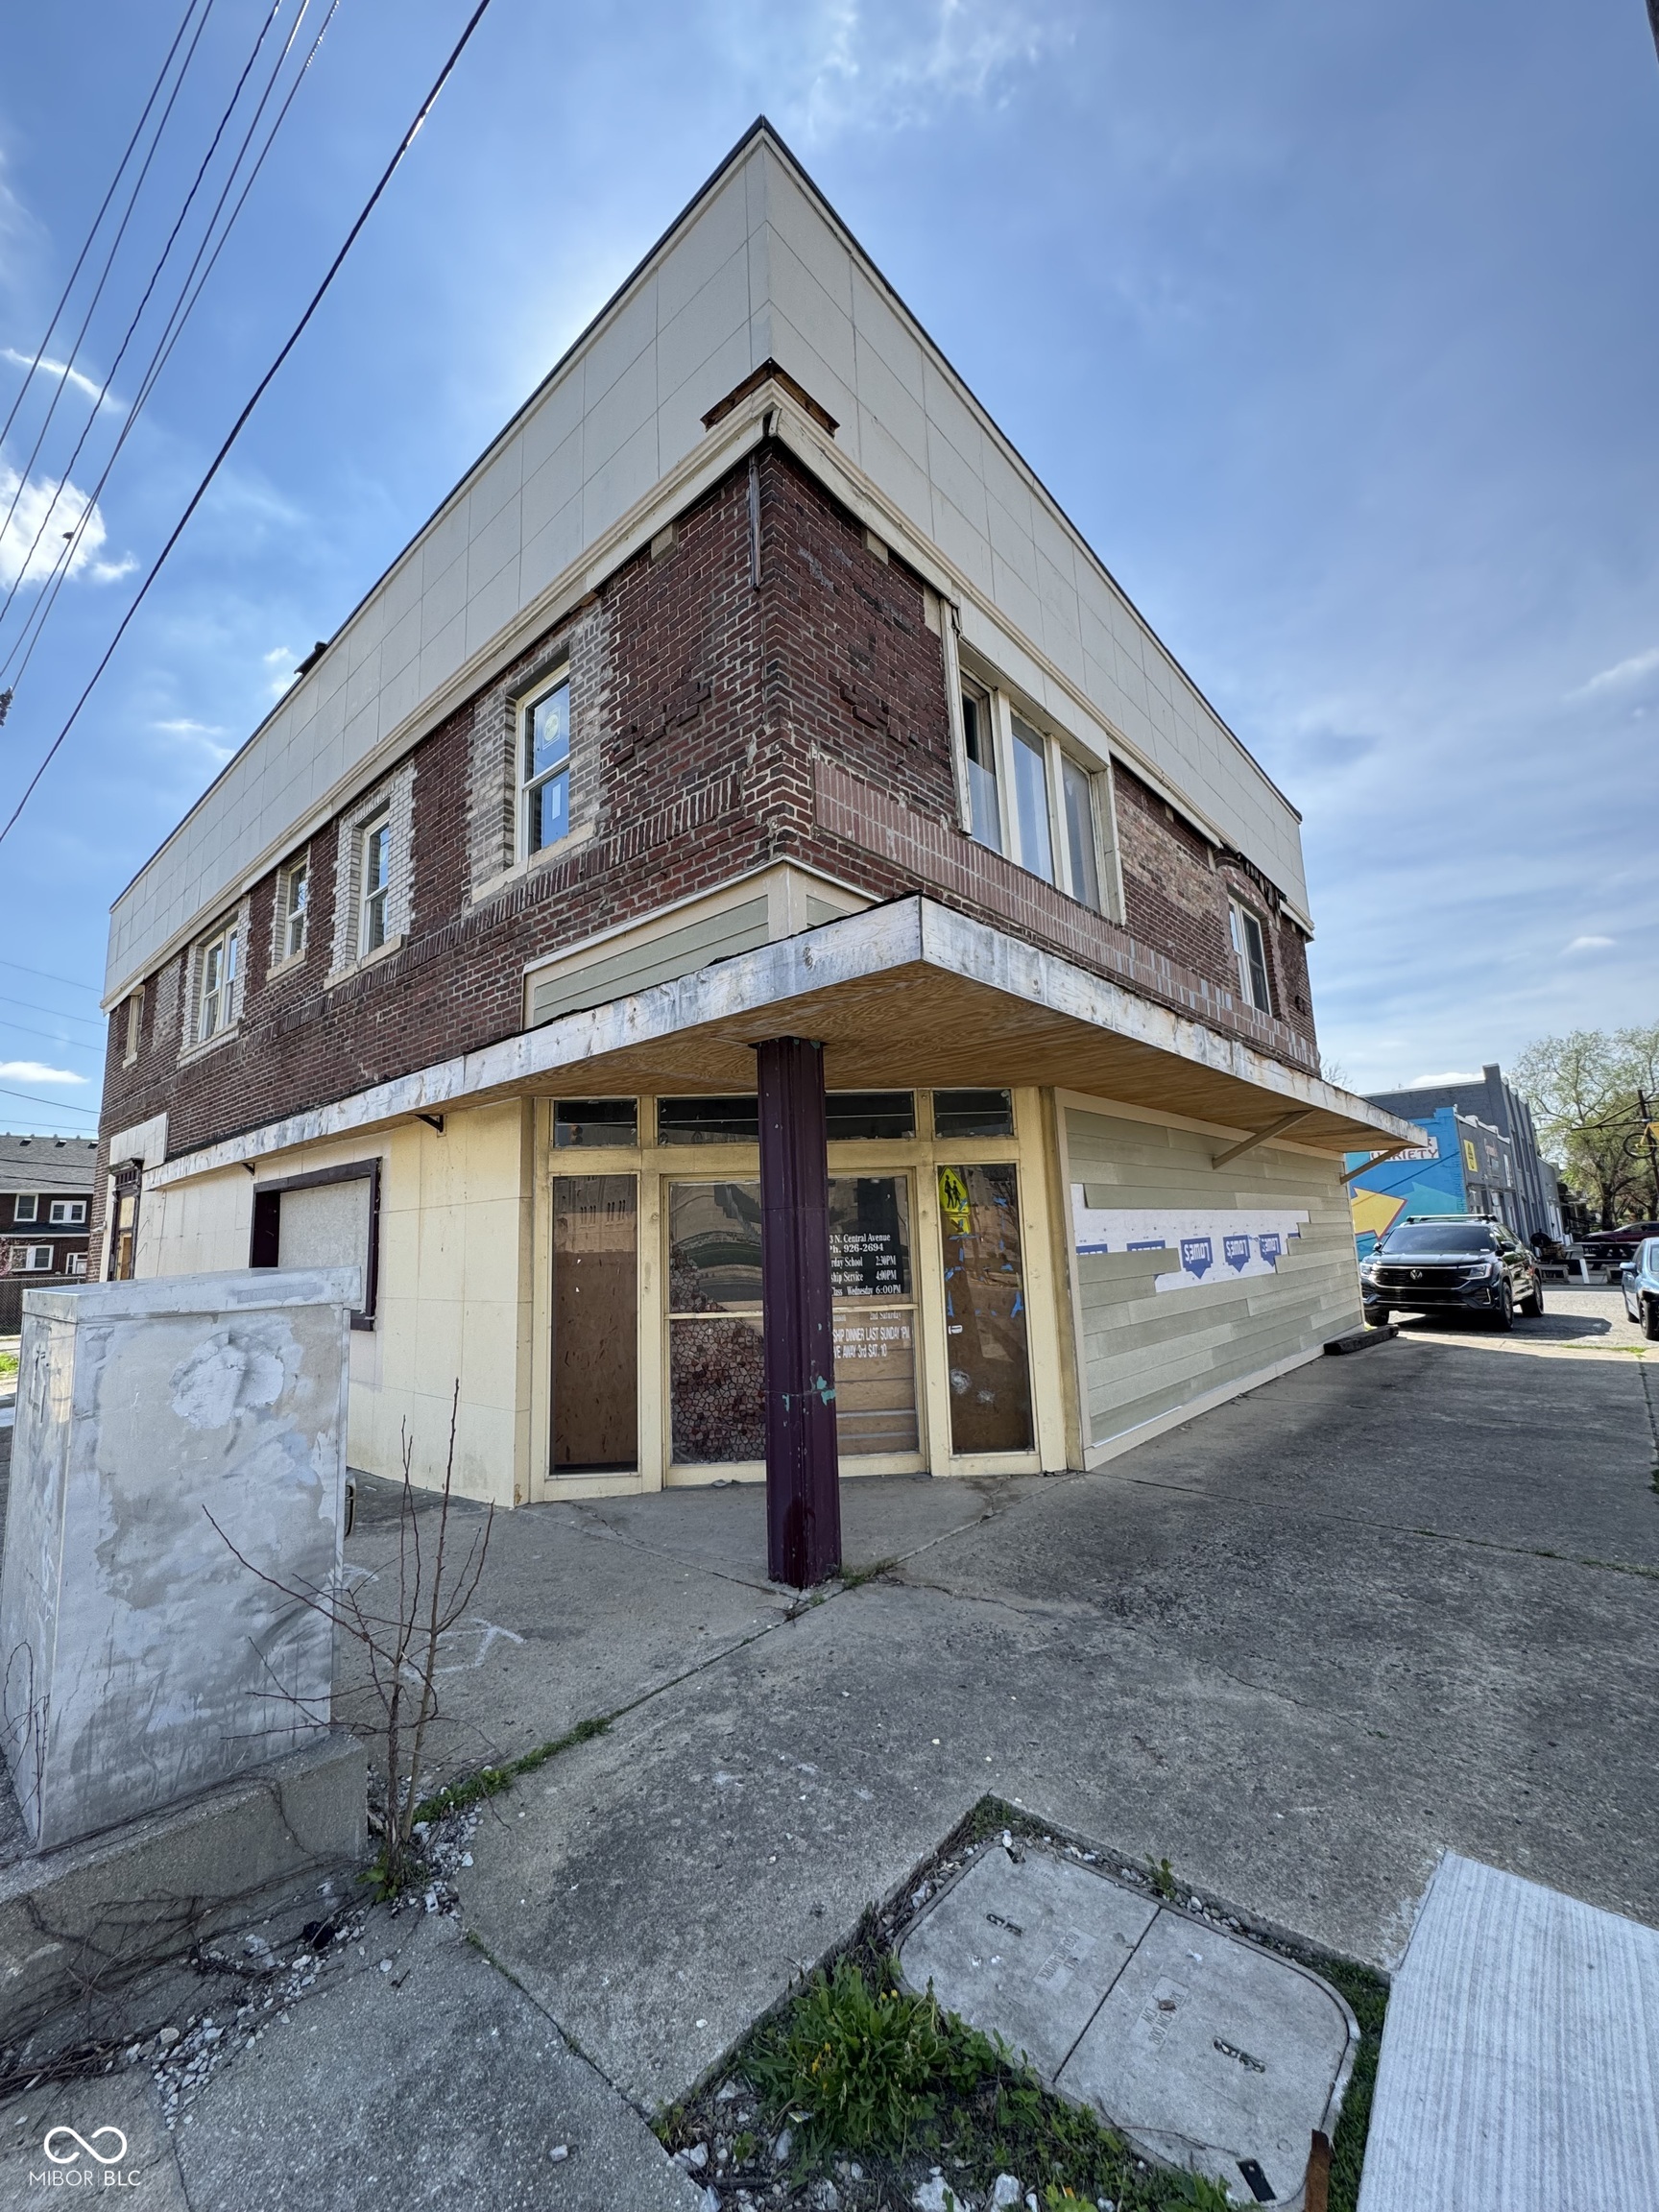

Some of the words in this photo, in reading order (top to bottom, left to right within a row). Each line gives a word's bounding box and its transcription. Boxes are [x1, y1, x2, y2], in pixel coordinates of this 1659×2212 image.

[835, 1234, 842, 1243] N.
[843, 1233, 867, 1243] Central
[867, 1233, 891, 1242] Avenue
[843, 1242, 884, 1253] 926-2694
[844, 1256, 863, 1267] School
[843, 1271, 864, 1282] Service
[875, 1284, 902, 1295] 6:00PM
[845, 1327, 865, 1342] DINNER
[866, 1326, 879, 1341] LAST
[880, 1326, 900, 1340] SUNDAY
[843, 1345, 856, 1358] AWAY
[857, 1344, 867, 1358] 3rd
